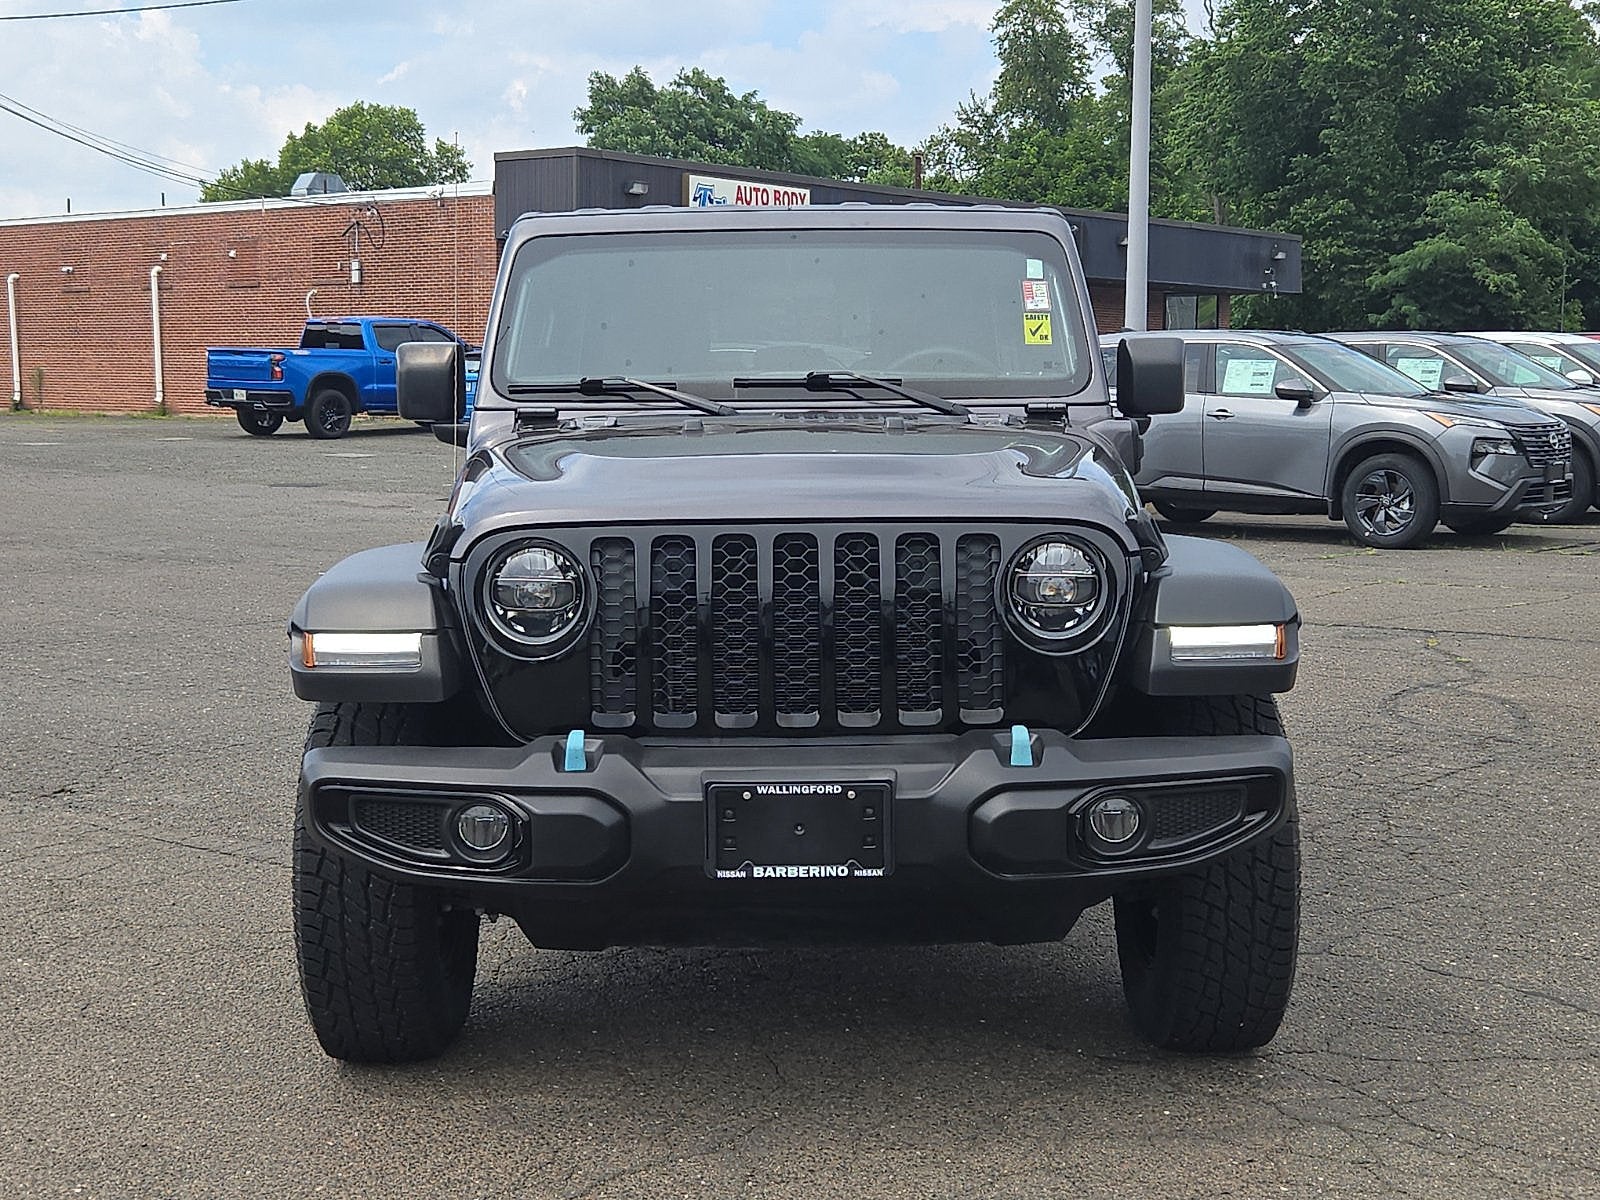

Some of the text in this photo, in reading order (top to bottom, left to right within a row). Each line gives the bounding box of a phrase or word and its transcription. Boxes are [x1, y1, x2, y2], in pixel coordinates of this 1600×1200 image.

[735, 184, 770, 207] AUTO
[773, 189, 807, 207] BODY
[756, 785, 843, 795] WALLINGFORD
[717, 866, 884, 878] NISSAN BARBERINO NISSAN
